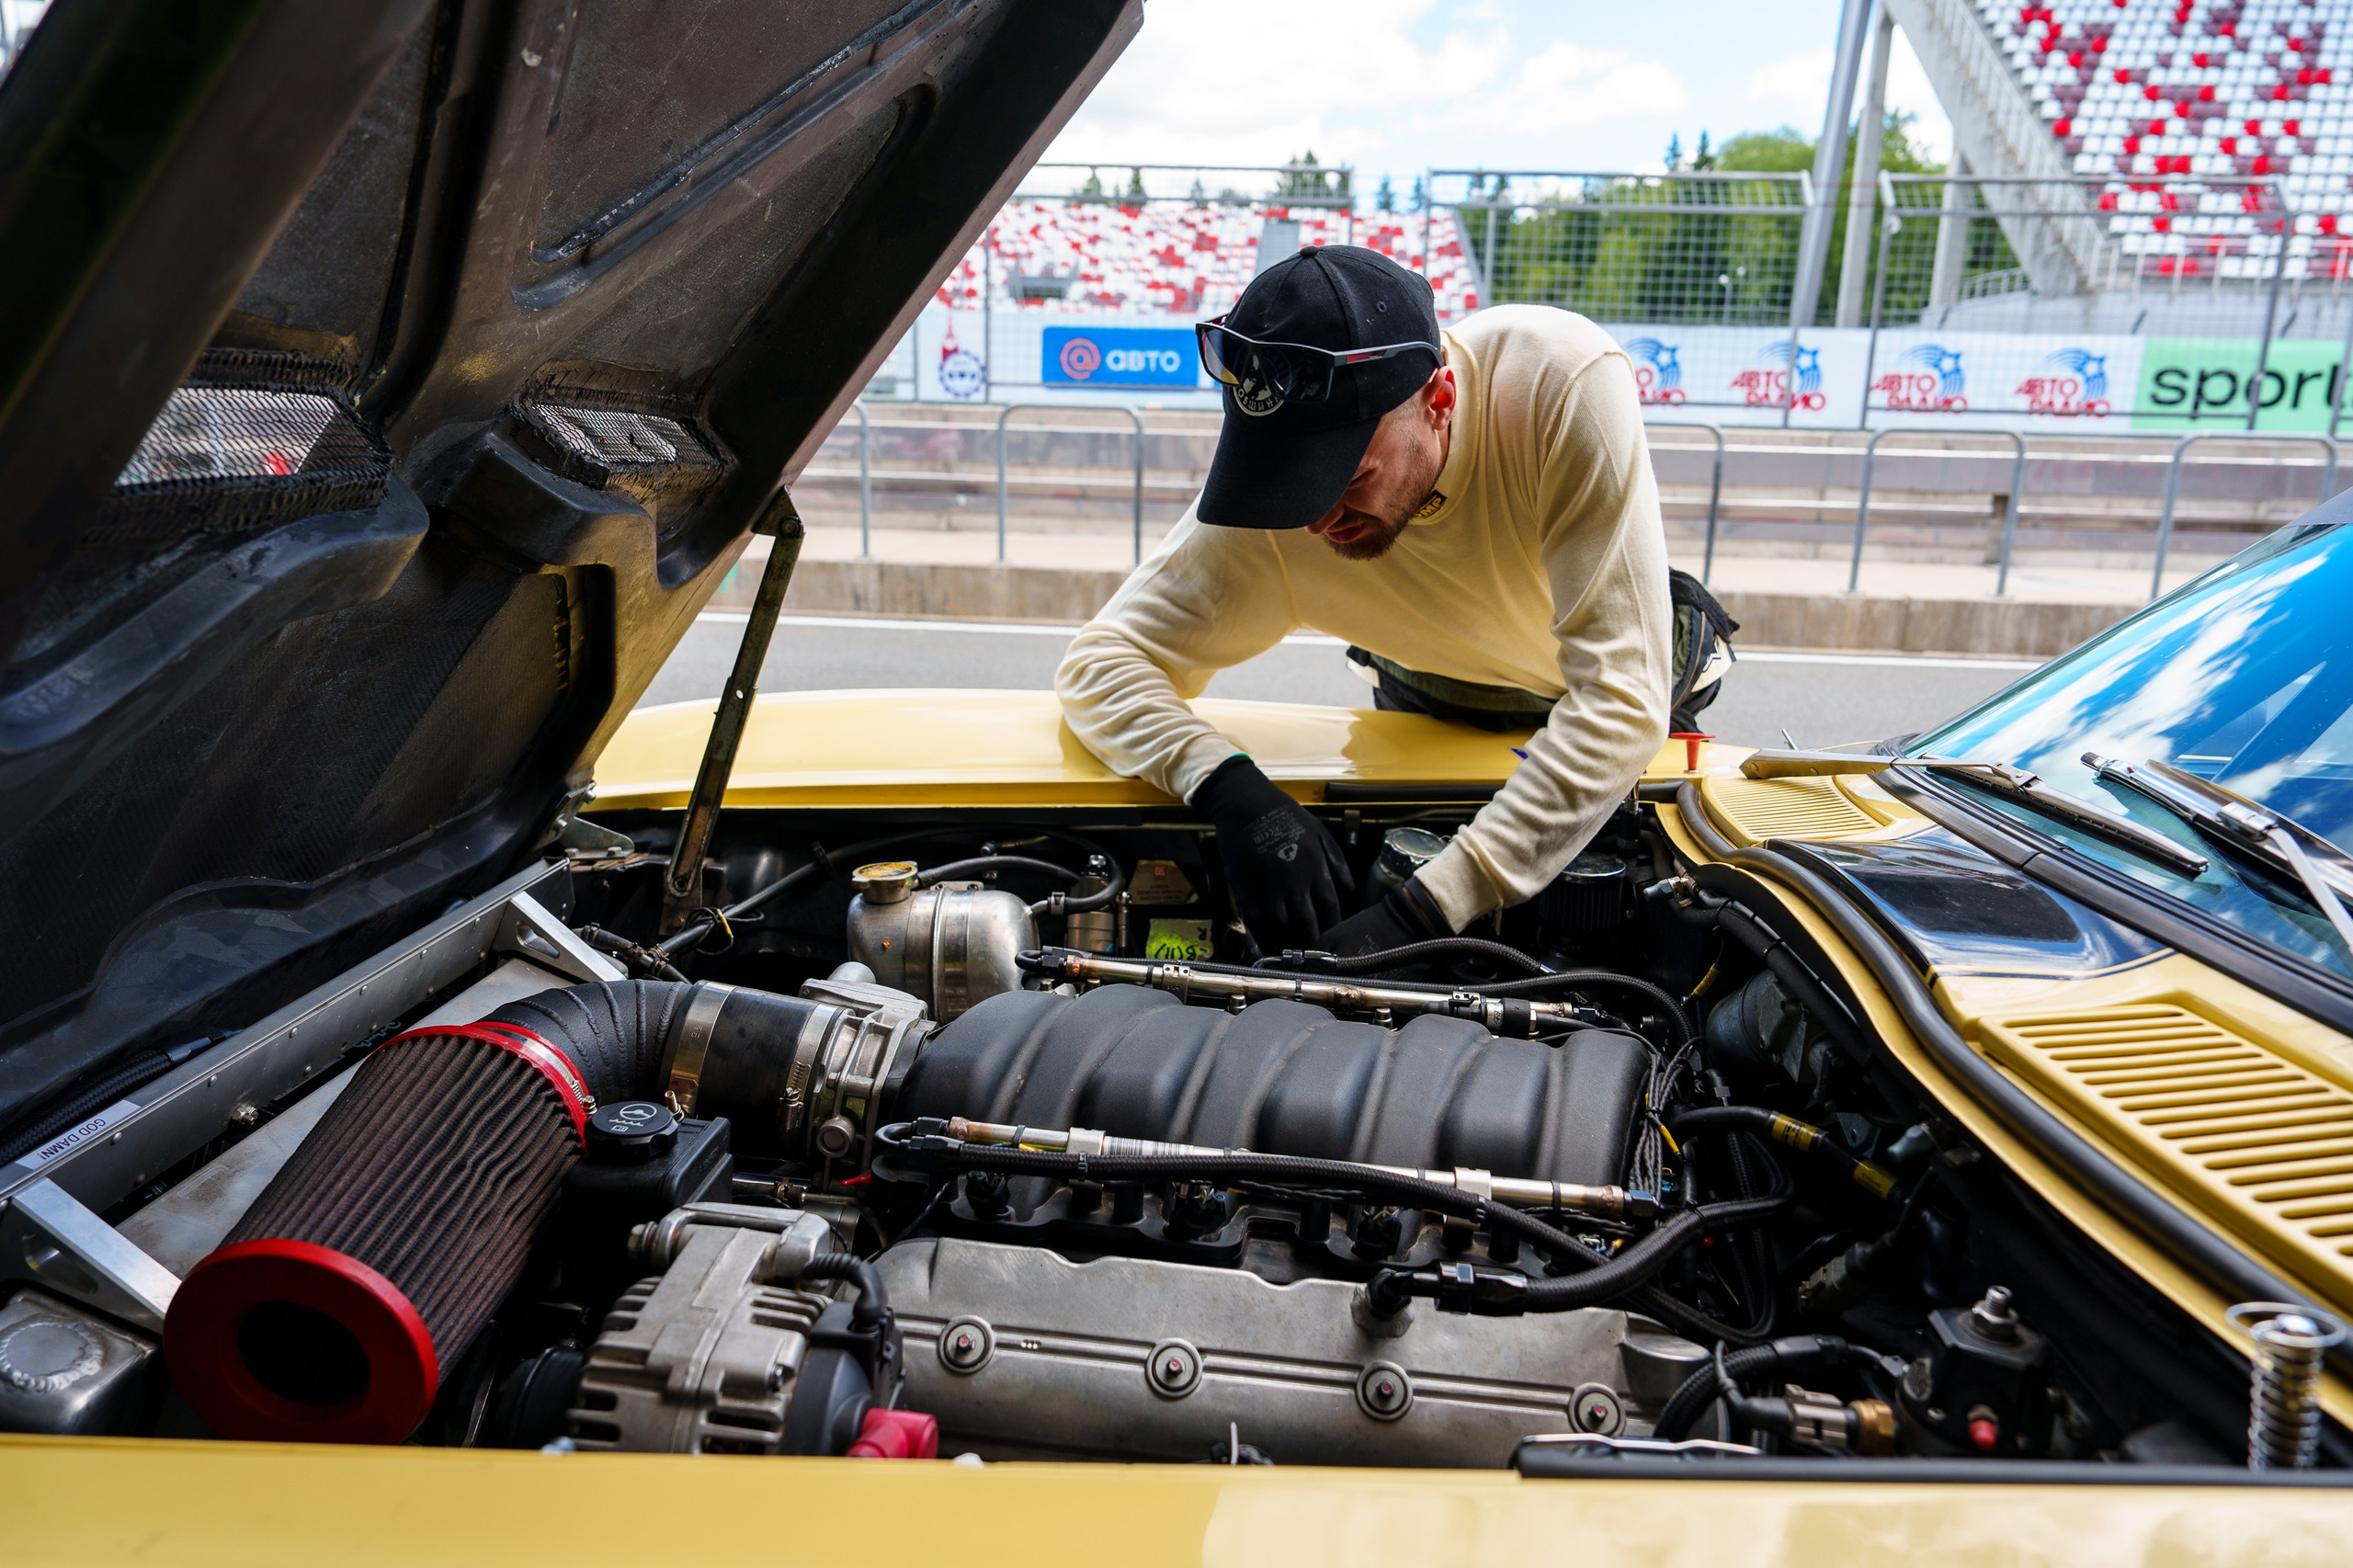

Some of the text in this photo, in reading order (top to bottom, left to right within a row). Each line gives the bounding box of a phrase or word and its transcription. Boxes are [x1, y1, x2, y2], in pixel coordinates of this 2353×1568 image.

[1869, 372, 1936, 395] АВТО
[2013, 377, 2079, 398] АВТО
[1197, 926, 1207, 940] R
[37, 1118, 107, 1160] GOD DAMN!
